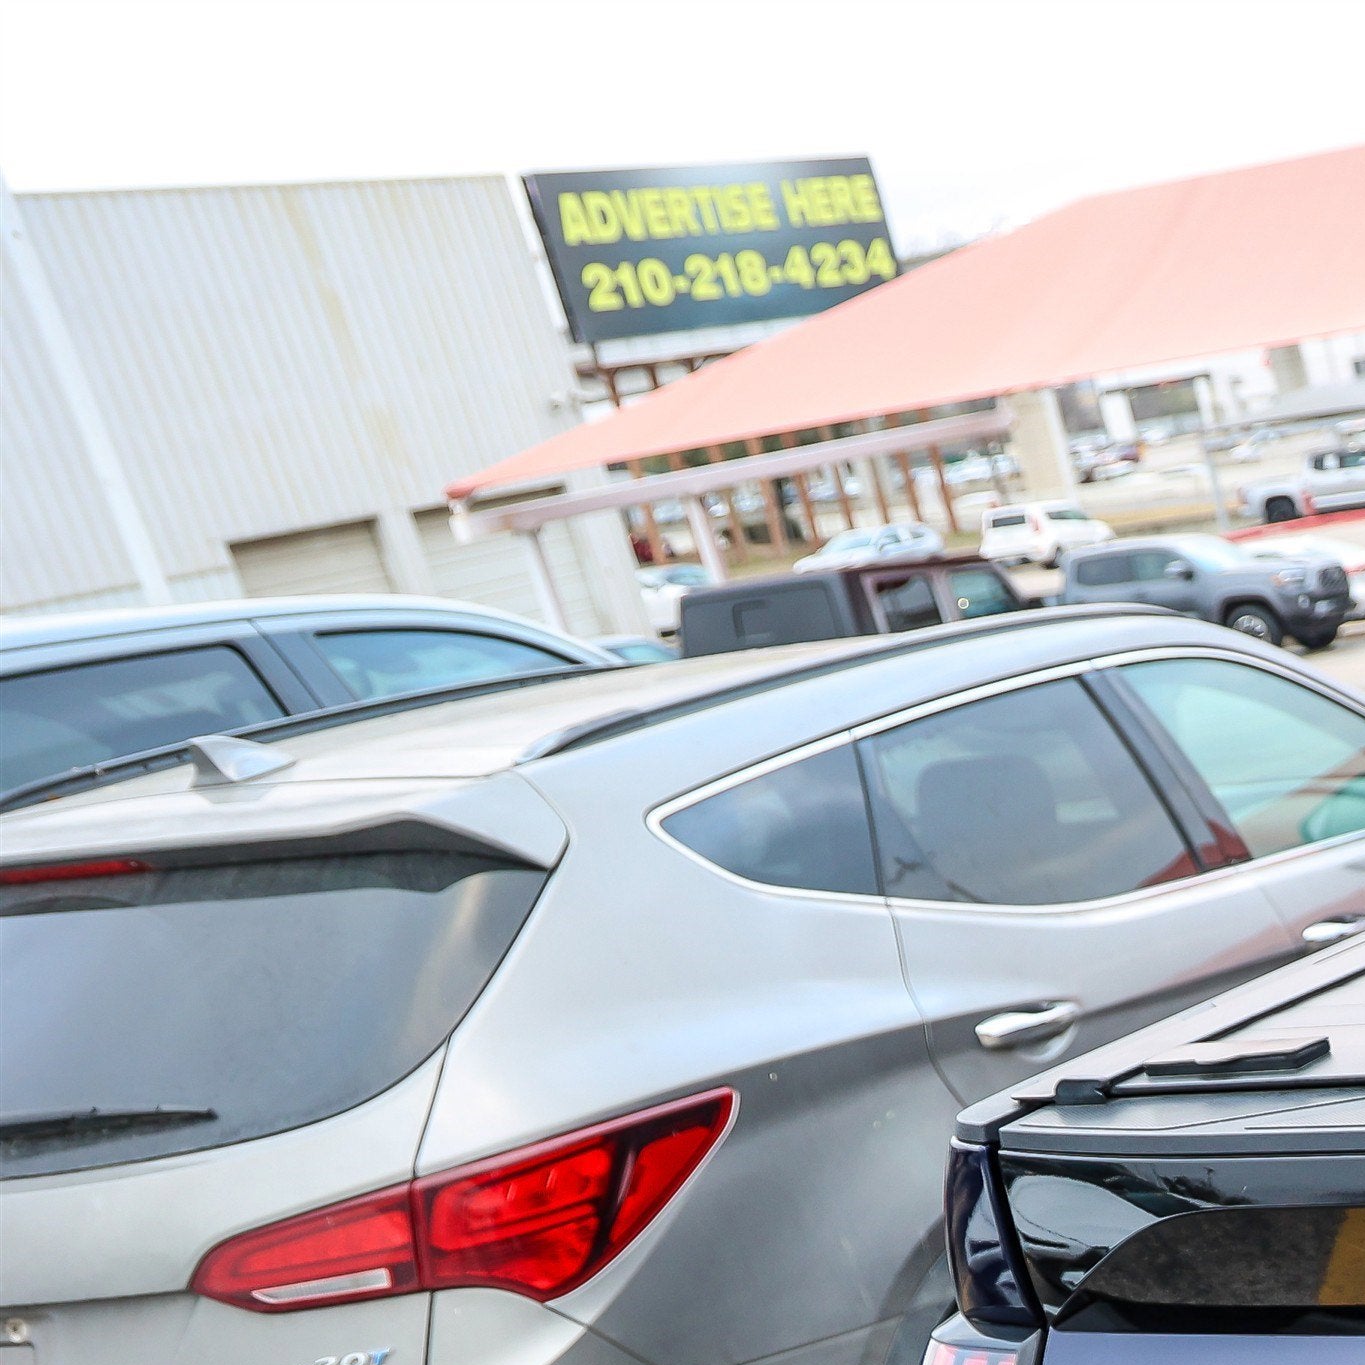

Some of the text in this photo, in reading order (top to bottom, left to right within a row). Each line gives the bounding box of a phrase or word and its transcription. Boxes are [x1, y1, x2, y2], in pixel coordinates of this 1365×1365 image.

[558, 173, 885, 246] ADVERTISE HERE
[581, 236, 897, 312] 210-218-4234
